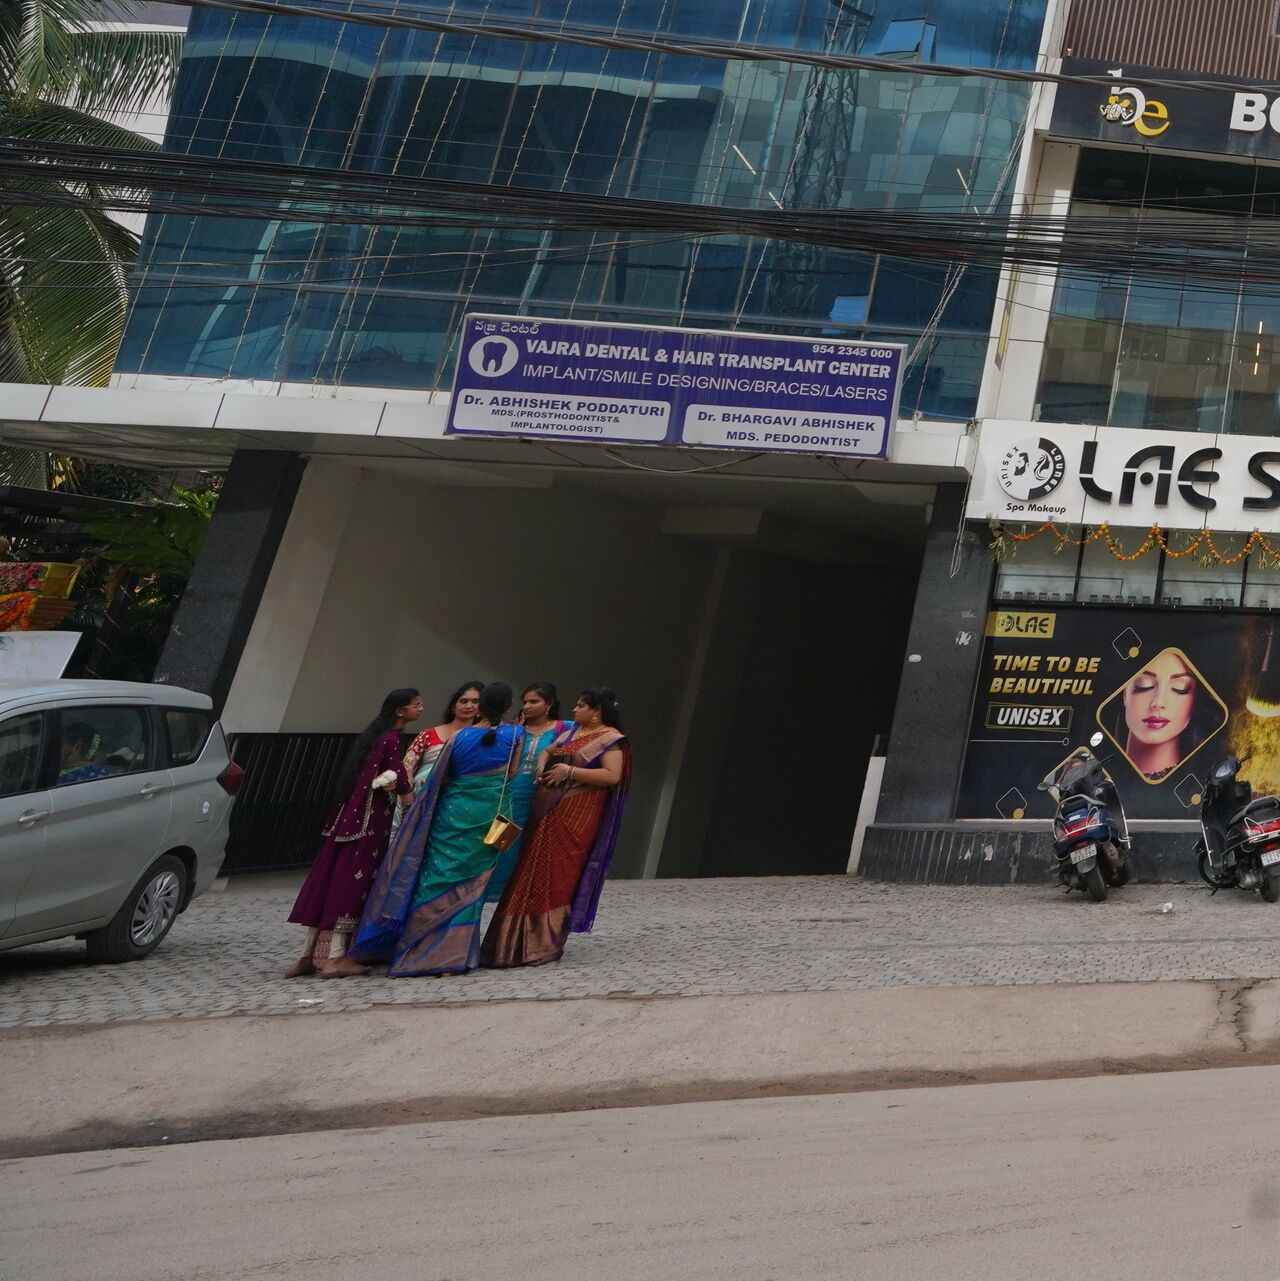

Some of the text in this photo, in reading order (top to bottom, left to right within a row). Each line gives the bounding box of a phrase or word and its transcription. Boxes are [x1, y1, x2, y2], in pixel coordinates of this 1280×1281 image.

[526, 339, 891, 379] VAJRA DENTAL & HAIR TRANSPLANT CENTER
[812, 345, 893, 359] 954 2345 000
[522, 364, 888, 401] IMPLANT/SMILE DESIGNING/BRACES/LASERS
[464, 394, 665, 417] Dr. ABHISHEK PODDATURI
[510, 421, 604, 434] IMPLANTOLOGIST)
[697, 411, 876, 432] Dr. BHARGAVI ABHISHEK
[726, 431, 861, 447] MDS. PEDODONTIST
[1006, 503, 1066, 515] Spa Makeup
[994, 655, 1101, 673] TIME TO BE
[989, 677, 1094, 695] BEAUTIFUL
[997, 708, 1064, 726] UNISEX
